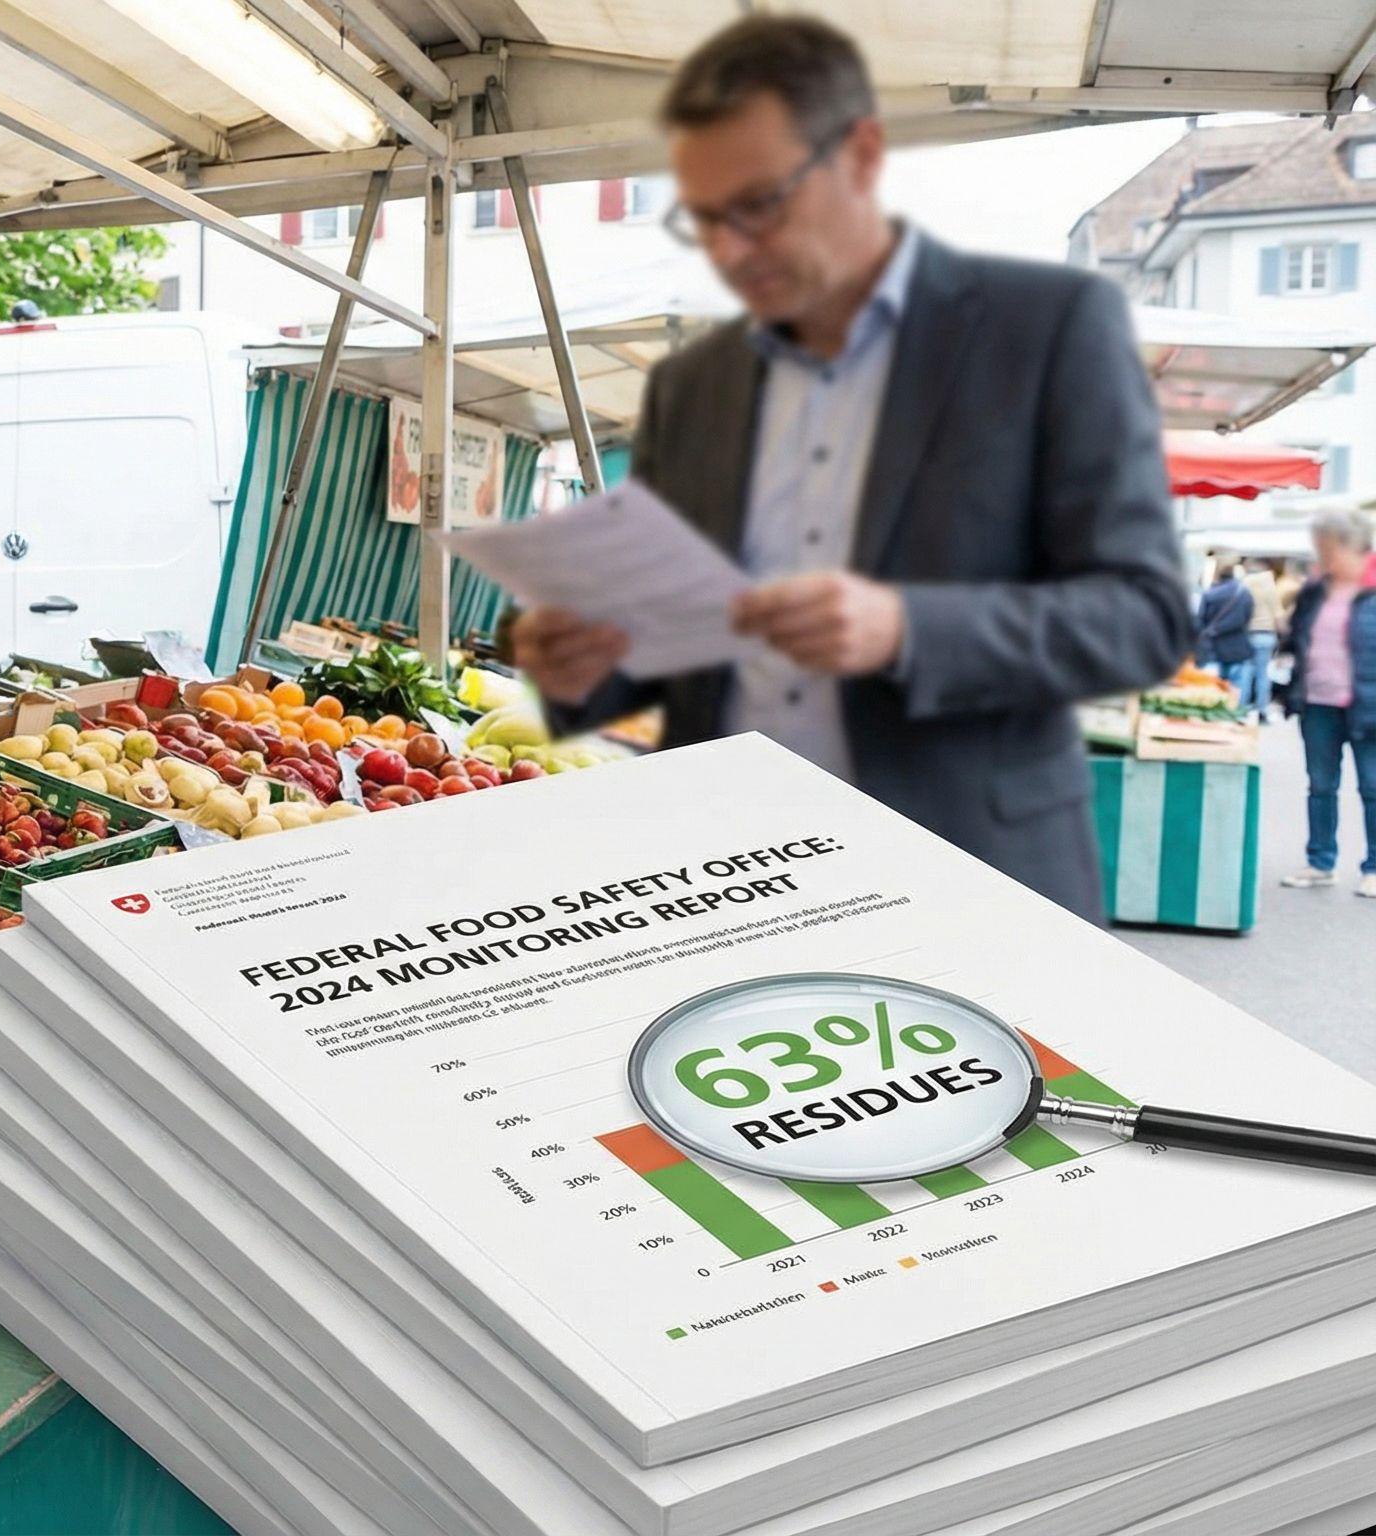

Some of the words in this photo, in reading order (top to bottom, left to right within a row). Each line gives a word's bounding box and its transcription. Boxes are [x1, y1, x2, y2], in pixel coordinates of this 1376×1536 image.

[238, 932, 428, 987] FEDERAL
[426, 904, 547, 943] FOOD
[550, 867, 693, 915] SAFETY
[701, 836, 845, 879] OFFICE:
[268, 974, 374, 1014] 2024
[375, 910, 650, 988] MONITORING
[649, 873, 800, 923] REPORT
[674, 1001, 957, 1110] 63%
[430, 1059, 467, 1073] 70%
[463, 1087, 498, 1103] 60%
[732, 1058, 1003, 1151] RESIDUES
[495, 1114, 531, 1130] 50%
[530, 1143, 565, 1158] 40%
[562, 1173, 601, 1189] 30%
[599, 1203, 637, 1221] 20%
[766, 1254, 807, 1273] 2021
[867, 1223, 909, 1242] 2022
[964, 1193, 1004, 1212] 2023
[1055, 1165, 1096, 1183] 2024
[638, 1235, 674, 1251] 10%
[697, 1267, 711, 1278] 0
